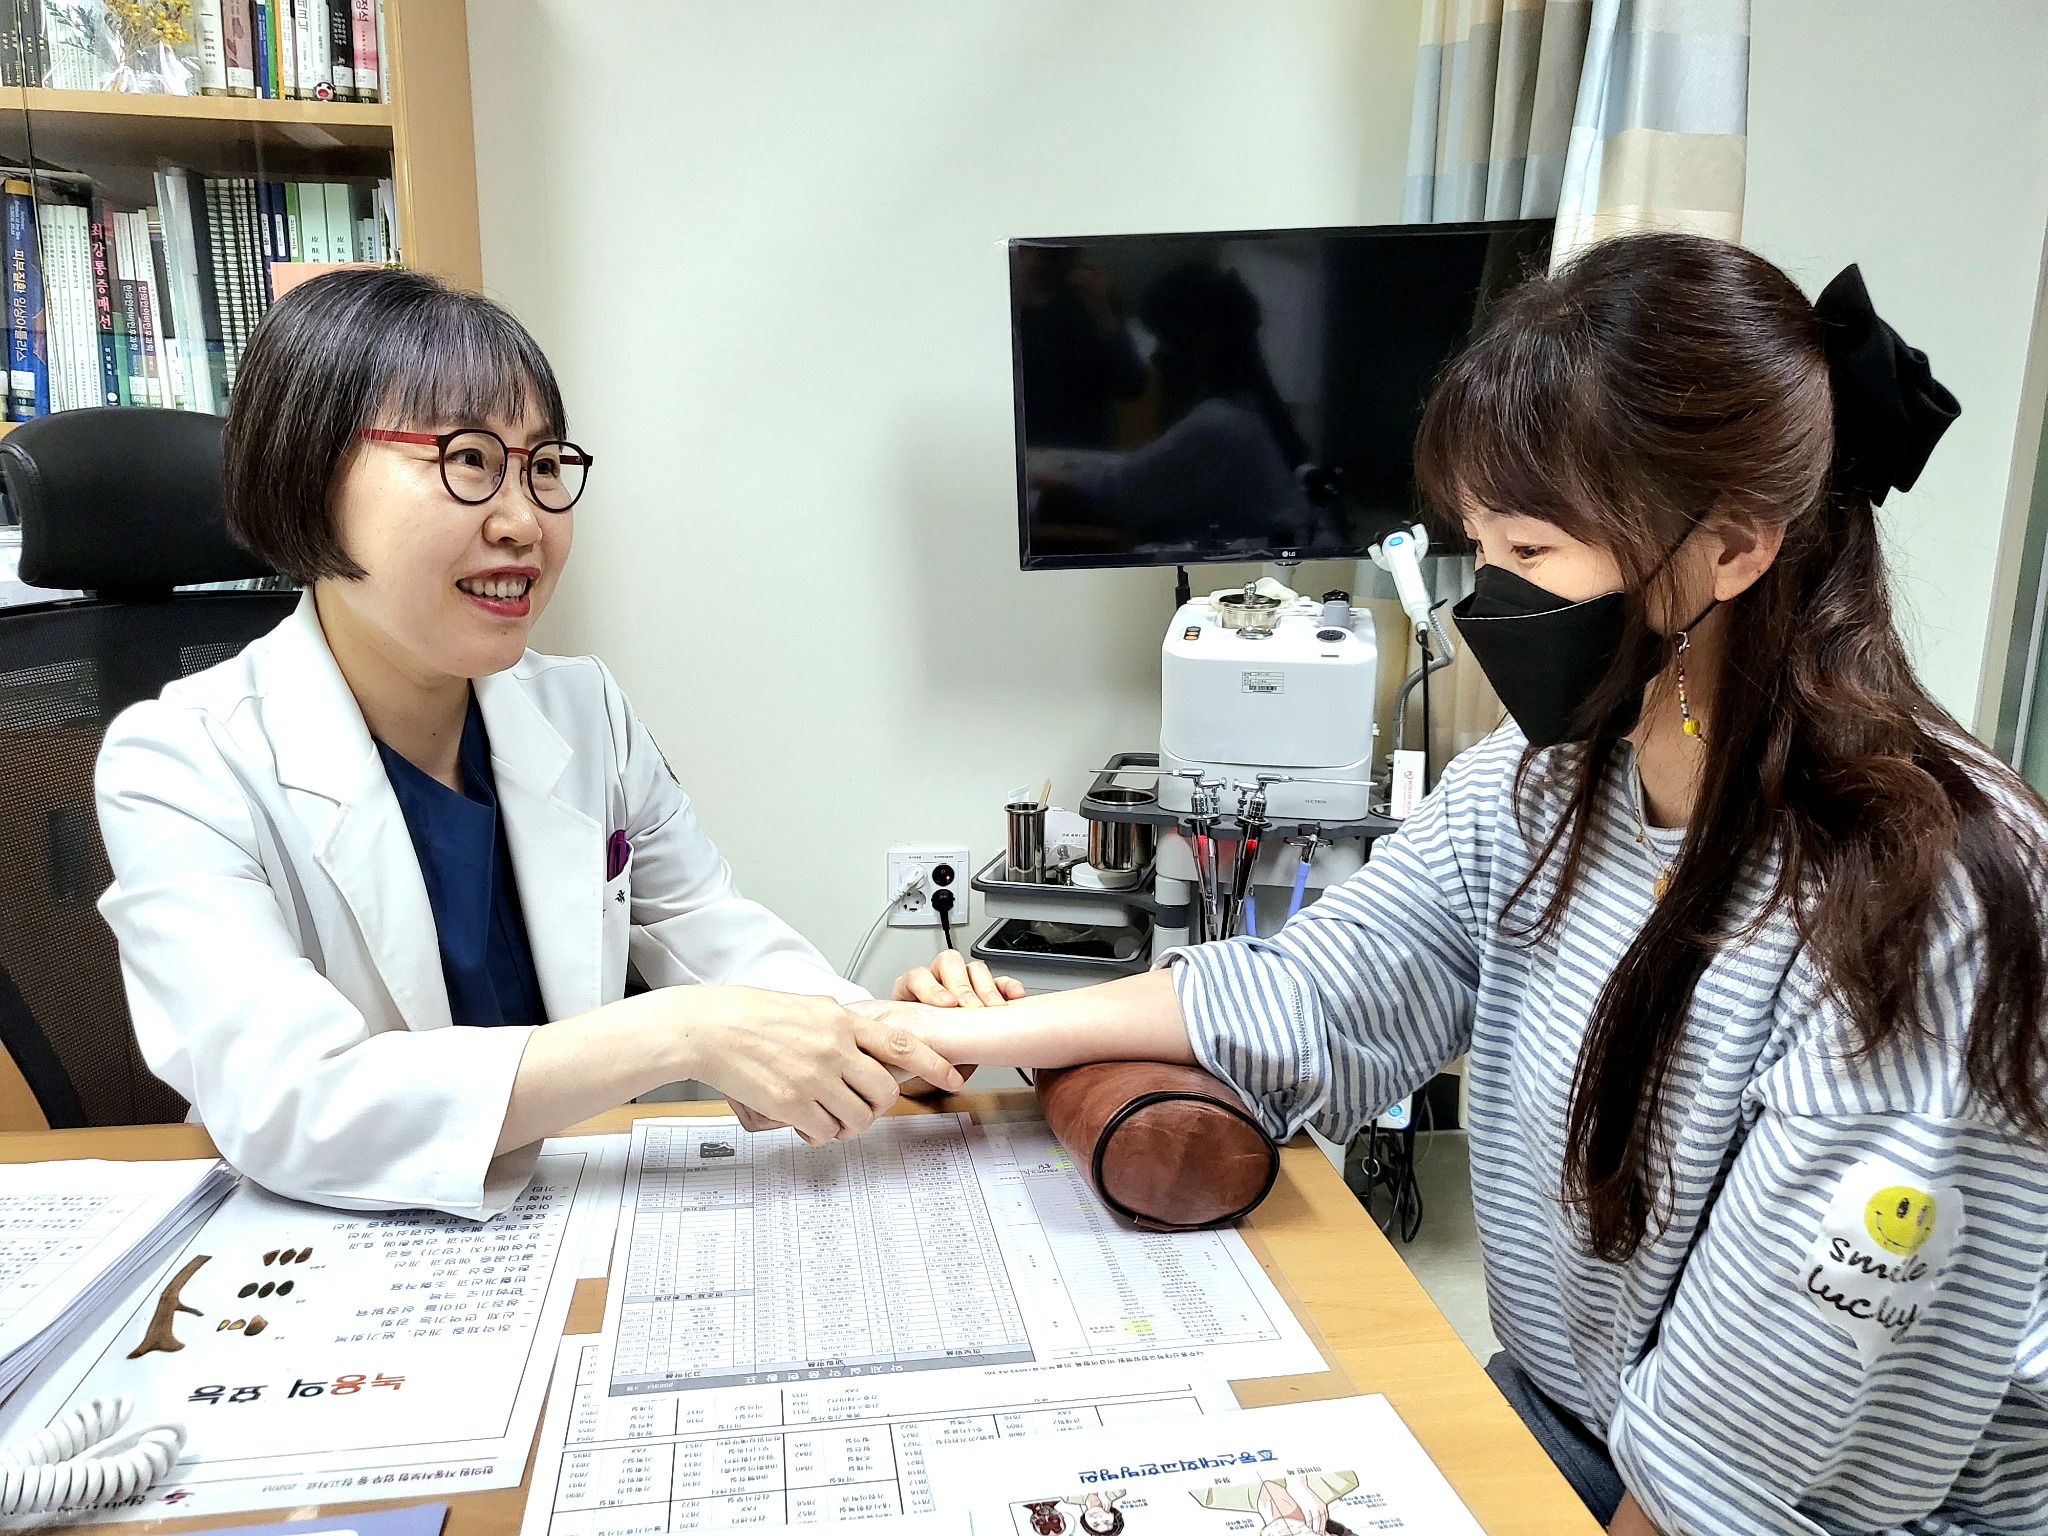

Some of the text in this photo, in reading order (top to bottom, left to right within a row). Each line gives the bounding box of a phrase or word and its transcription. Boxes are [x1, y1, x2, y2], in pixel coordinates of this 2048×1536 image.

[91, 223, 111, 330] 최강통증매선
[12, 248, 28, 362] 피부질환 임상아틀라스
[493, 1223, 544, 1232] 스트레스
[432, 1269, 458, 1277] 개선
[355, 1305, 414, 1317] 성장발육
[425, 1303, 467, 1312] 아이들
[419, 1314, 477, 1325] 면역기능
[452, 1324, 511, 1335] 허약체질
[335, 1332, 395, 1343] 원기회복
[187, 1373, 406, 1405] 녹용의 효능
[459, 1465, 494, 1477] 한의원
[1078, 1451, 1257, 1484] 동신대학교한방병원
[372, 1474, 395, 1484] 업무
[398, 1469, 457, 1482] 자동차보험
[306, 1477, 353, 1490] 참고자료
